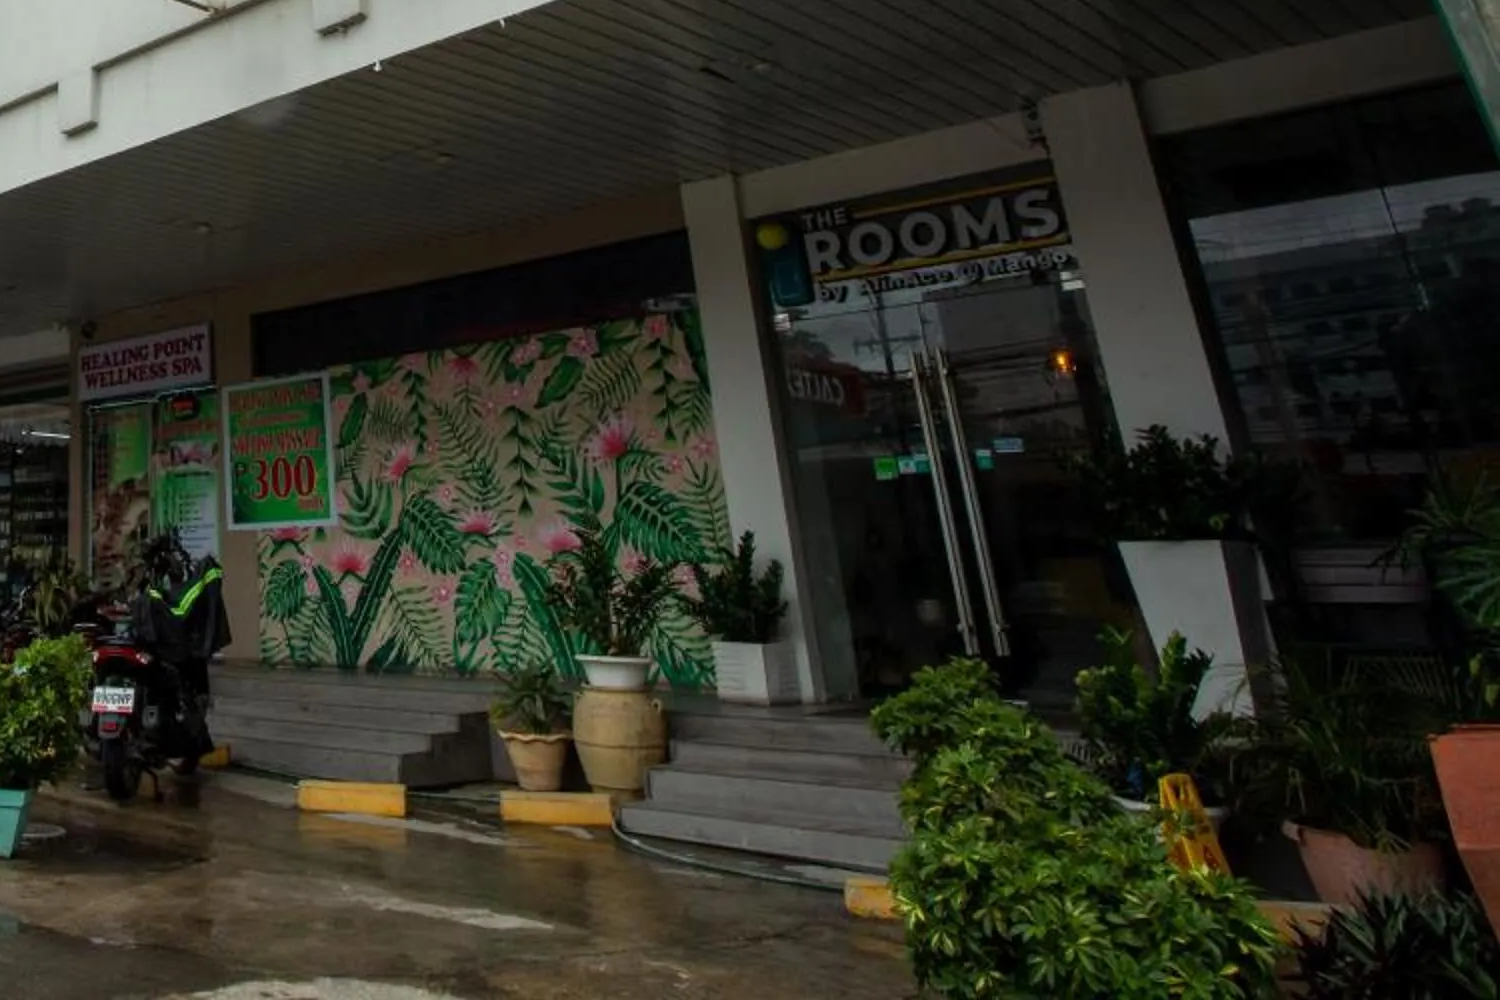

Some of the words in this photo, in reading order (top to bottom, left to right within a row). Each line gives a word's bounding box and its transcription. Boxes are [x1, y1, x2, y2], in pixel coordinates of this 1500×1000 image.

[804, 207, 847, 231] THE
[805, 188, 1061, 274] ROOMS
[818, 279, 849, 302] by
[985, 247, 1071, 278] Mango
[81, 344, 150, 372] HEALING
[153, 333, 205, 360] POINT
[85, 362, 168, 388] WELLNESS
[171, 356, 203, 377] SPA
[251, 454, 316, 500] 300
